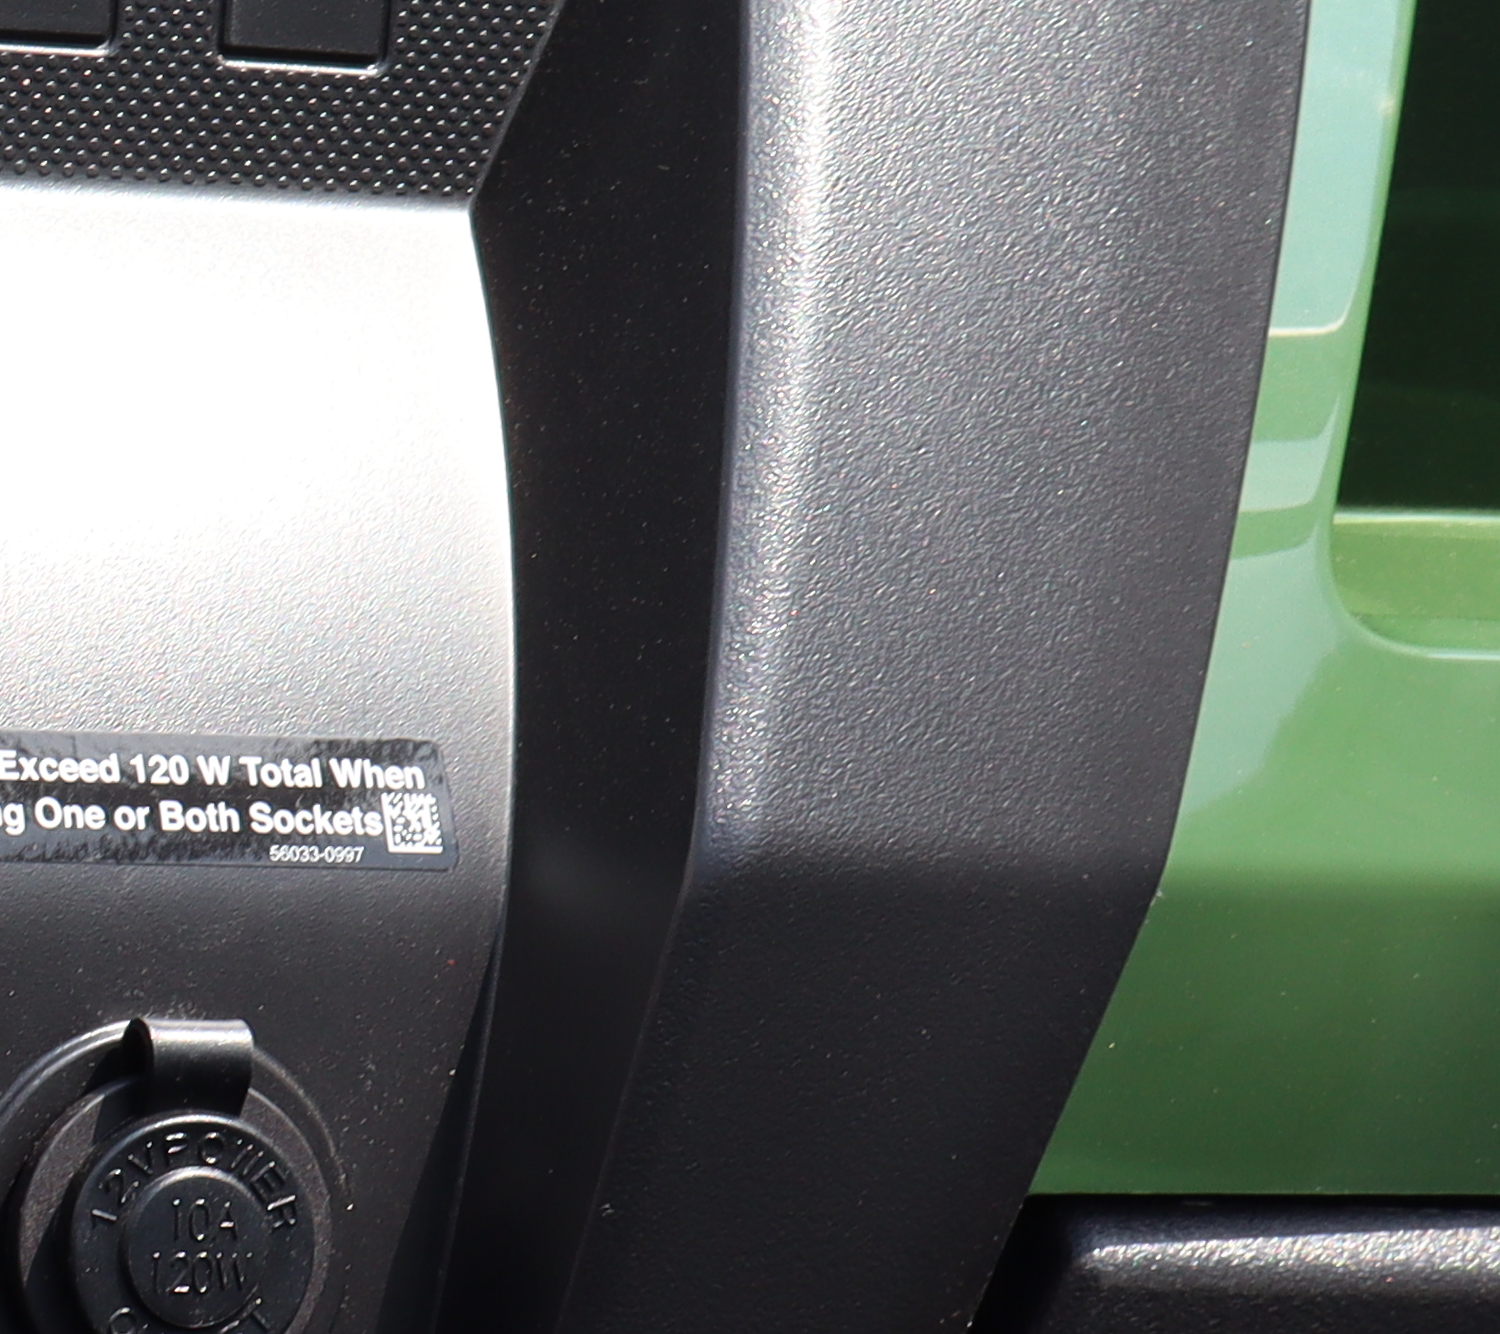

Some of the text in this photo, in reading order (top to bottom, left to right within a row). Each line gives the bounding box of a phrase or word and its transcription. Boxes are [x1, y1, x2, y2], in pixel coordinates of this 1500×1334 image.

[129, 753, 189, 786] 120
[196, 754, 231, 786] W
[238, 756, 322, 789] Total
[328, 758, 425, 791] When
[34, 795, 106, 831] One
[113, 804, 150, 832] or
[158, 800, 242, 834] Both
[249, 802, 383, 838] Sockets
[172, 1197, 240, 1244] 10A
[150, 1250, 255, 1296] 120W
